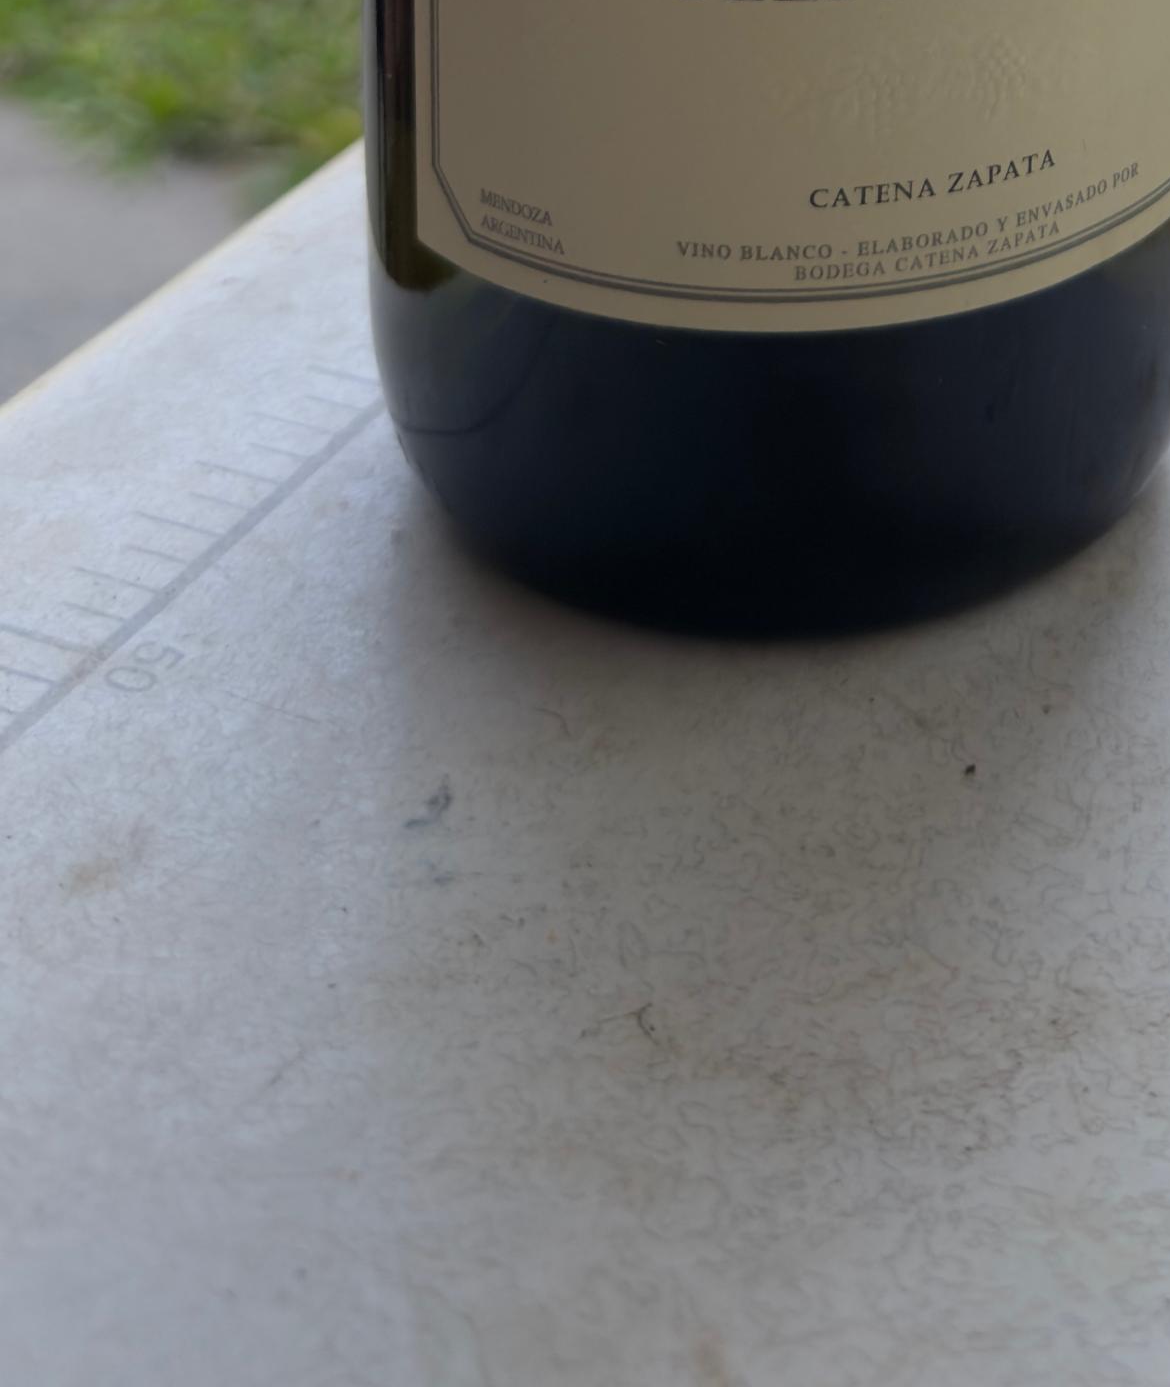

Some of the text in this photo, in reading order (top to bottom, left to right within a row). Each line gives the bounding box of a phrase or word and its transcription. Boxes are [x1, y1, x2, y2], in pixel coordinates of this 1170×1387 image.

[480, 187, 553, 226] MENDOZA
[808, 148, 1056, 209] CATENA ZAPATA
[481, 213, 565, 256] ARGENTINA
[676, 240, 732, 262] VINO
[739, 242, 833, 262] BLANCO
[856, 221, 988, 258] ELABORADO
[997, 217, 1008, 232] Y
[1015, 179, 1105, 228] ENVASADO
[1111, 161, 1139, 190] POR
[794, 220, 1060, 282] BODEGA CATENA ZAPATA
[103, 640, 186, 693] 50
